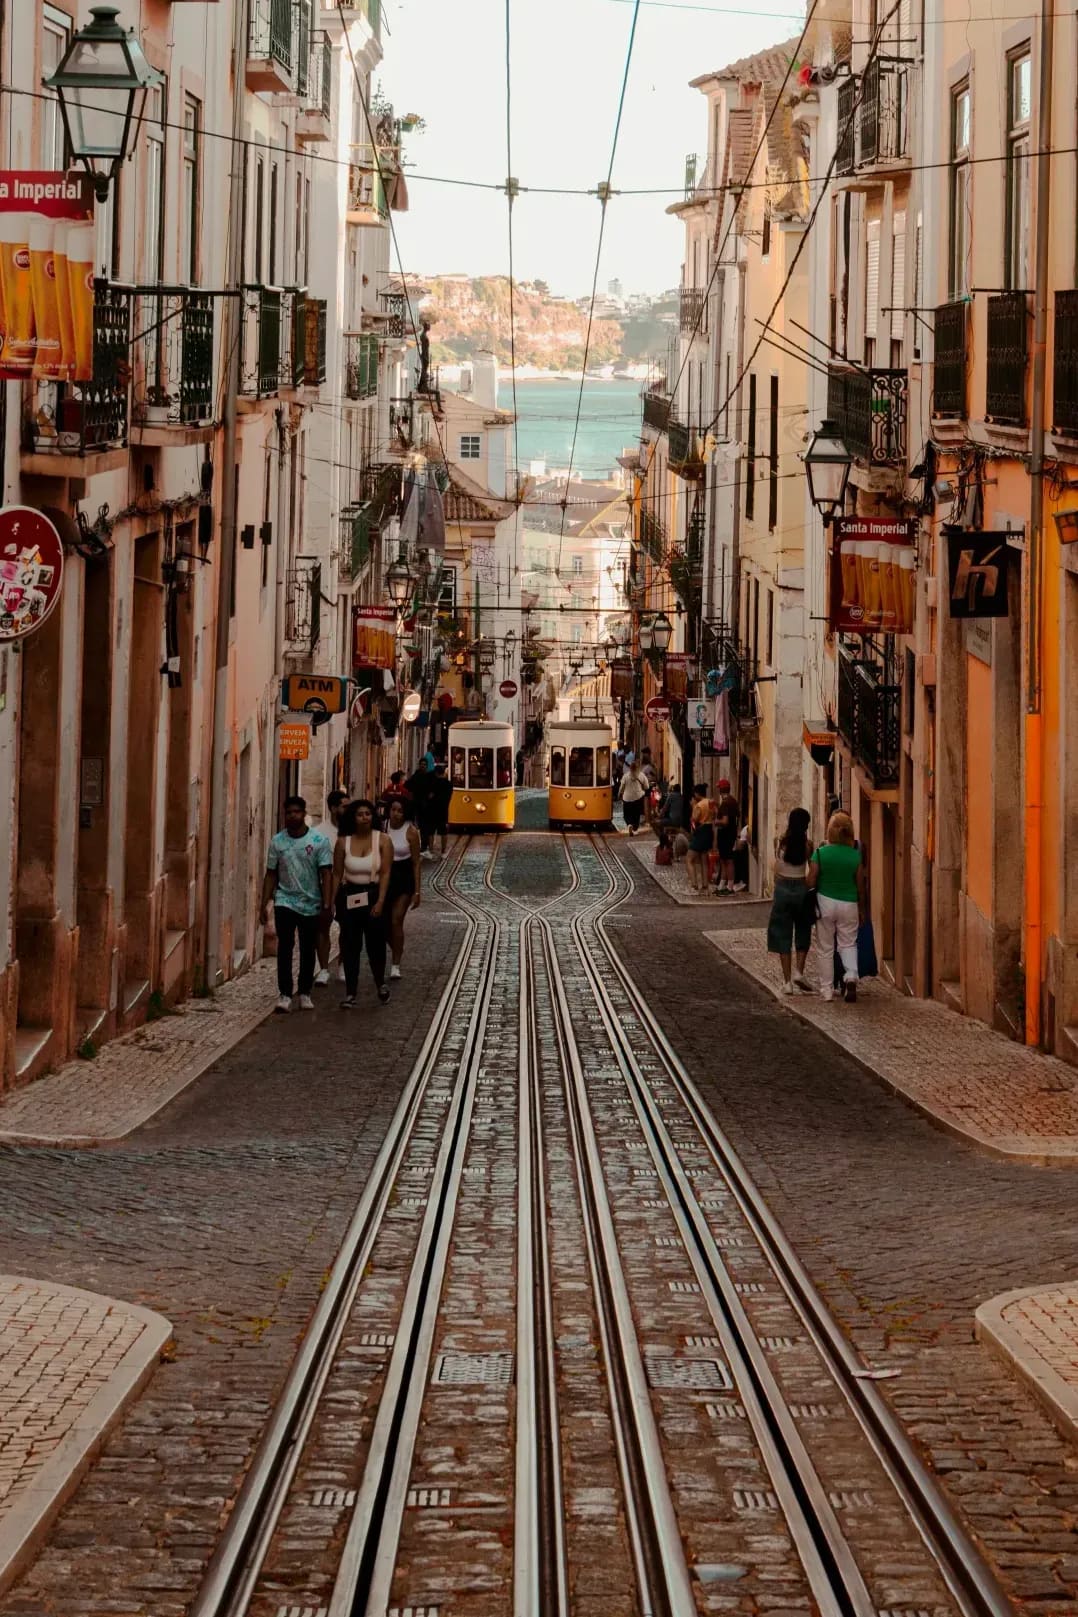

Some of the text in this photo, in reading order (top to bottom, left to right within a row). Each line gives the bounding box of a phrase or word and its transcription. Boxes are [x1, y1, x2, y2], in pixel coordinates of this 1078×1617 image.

[14, 178, 82, 205] Imperial
[840, 521, 908, 536] Santa Imperial
[298, 679, 333, 693] ATM
